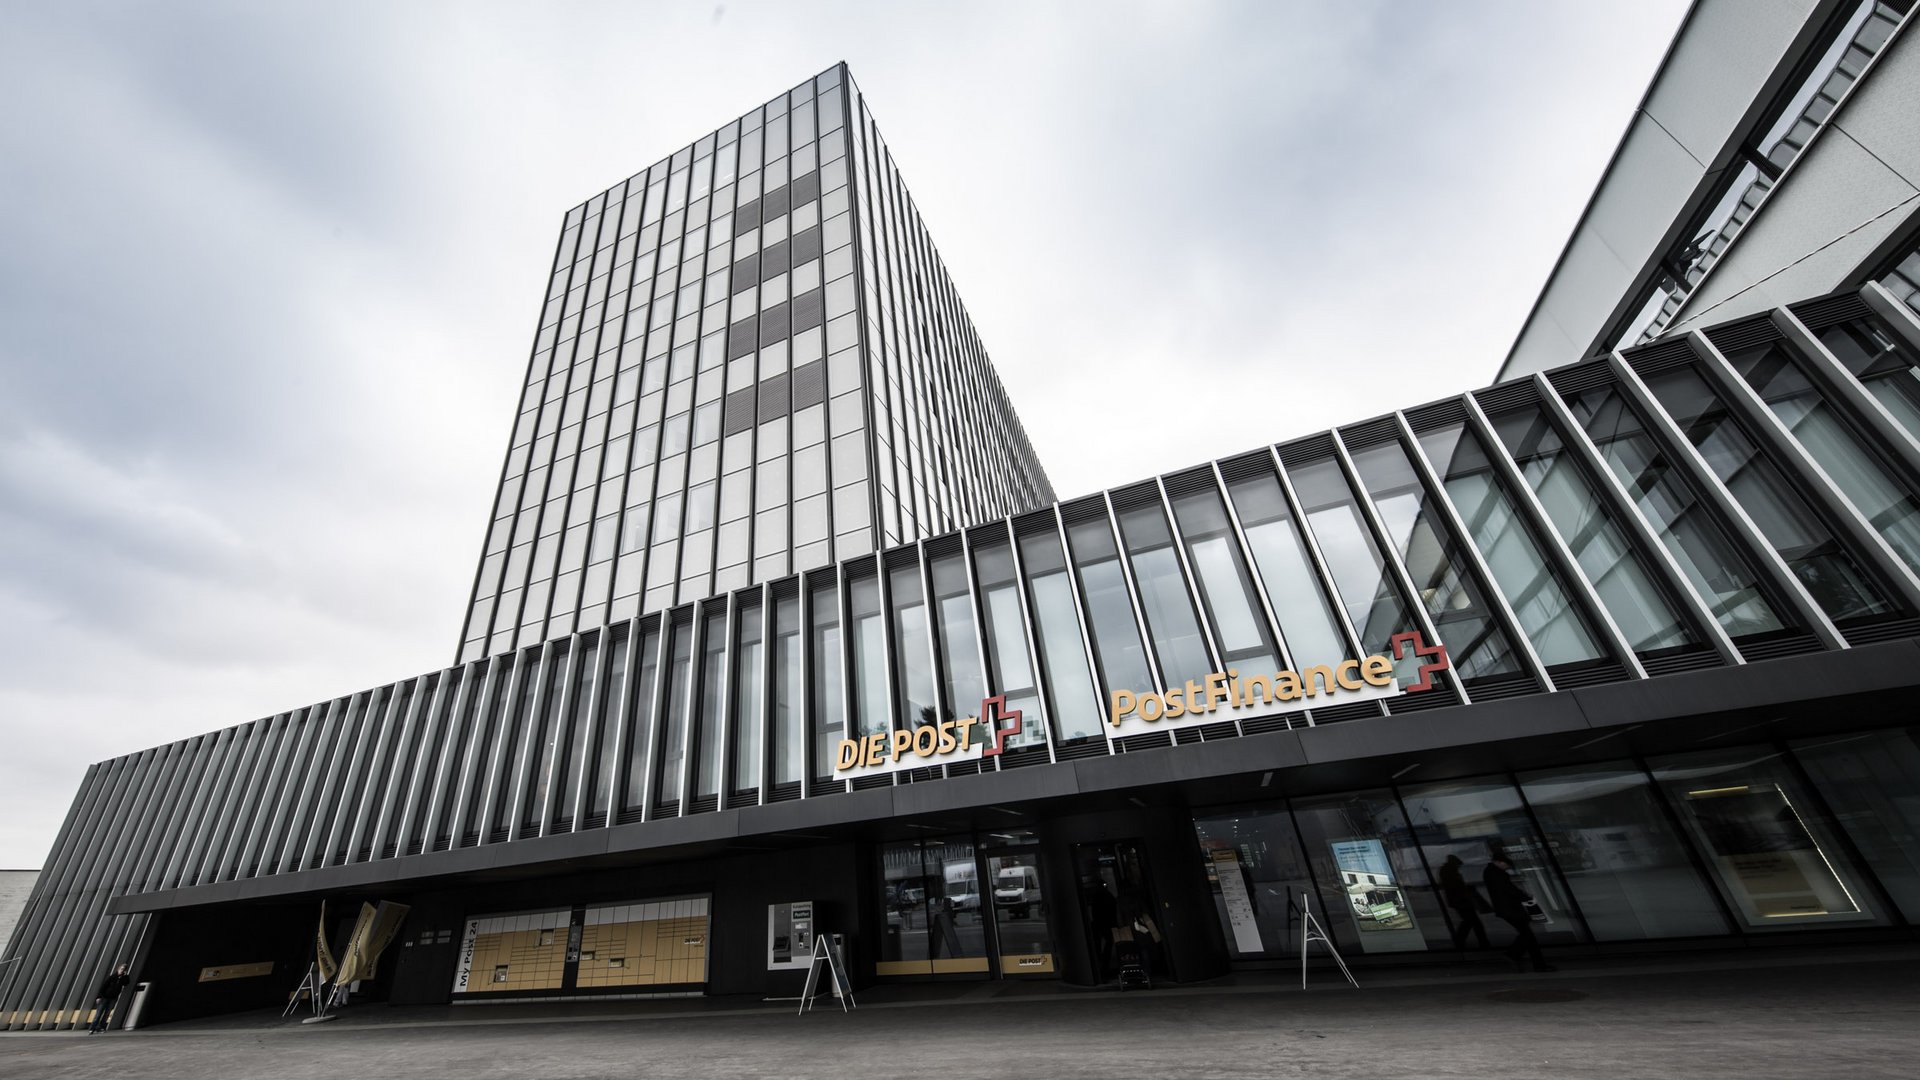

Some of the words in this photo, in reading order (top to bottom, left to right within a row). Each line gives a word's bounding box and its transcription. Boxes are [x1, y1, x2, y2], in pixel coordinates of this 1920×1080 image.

[1111, 655, 1394, 727] PostFinance
[836, 733, 887, 770] DIE
[892, 717, 979, 762] POST
[470, 922, 477, 935] 24
[464, 938, 474, 963] Post
[460, 968, 470, 986] My
